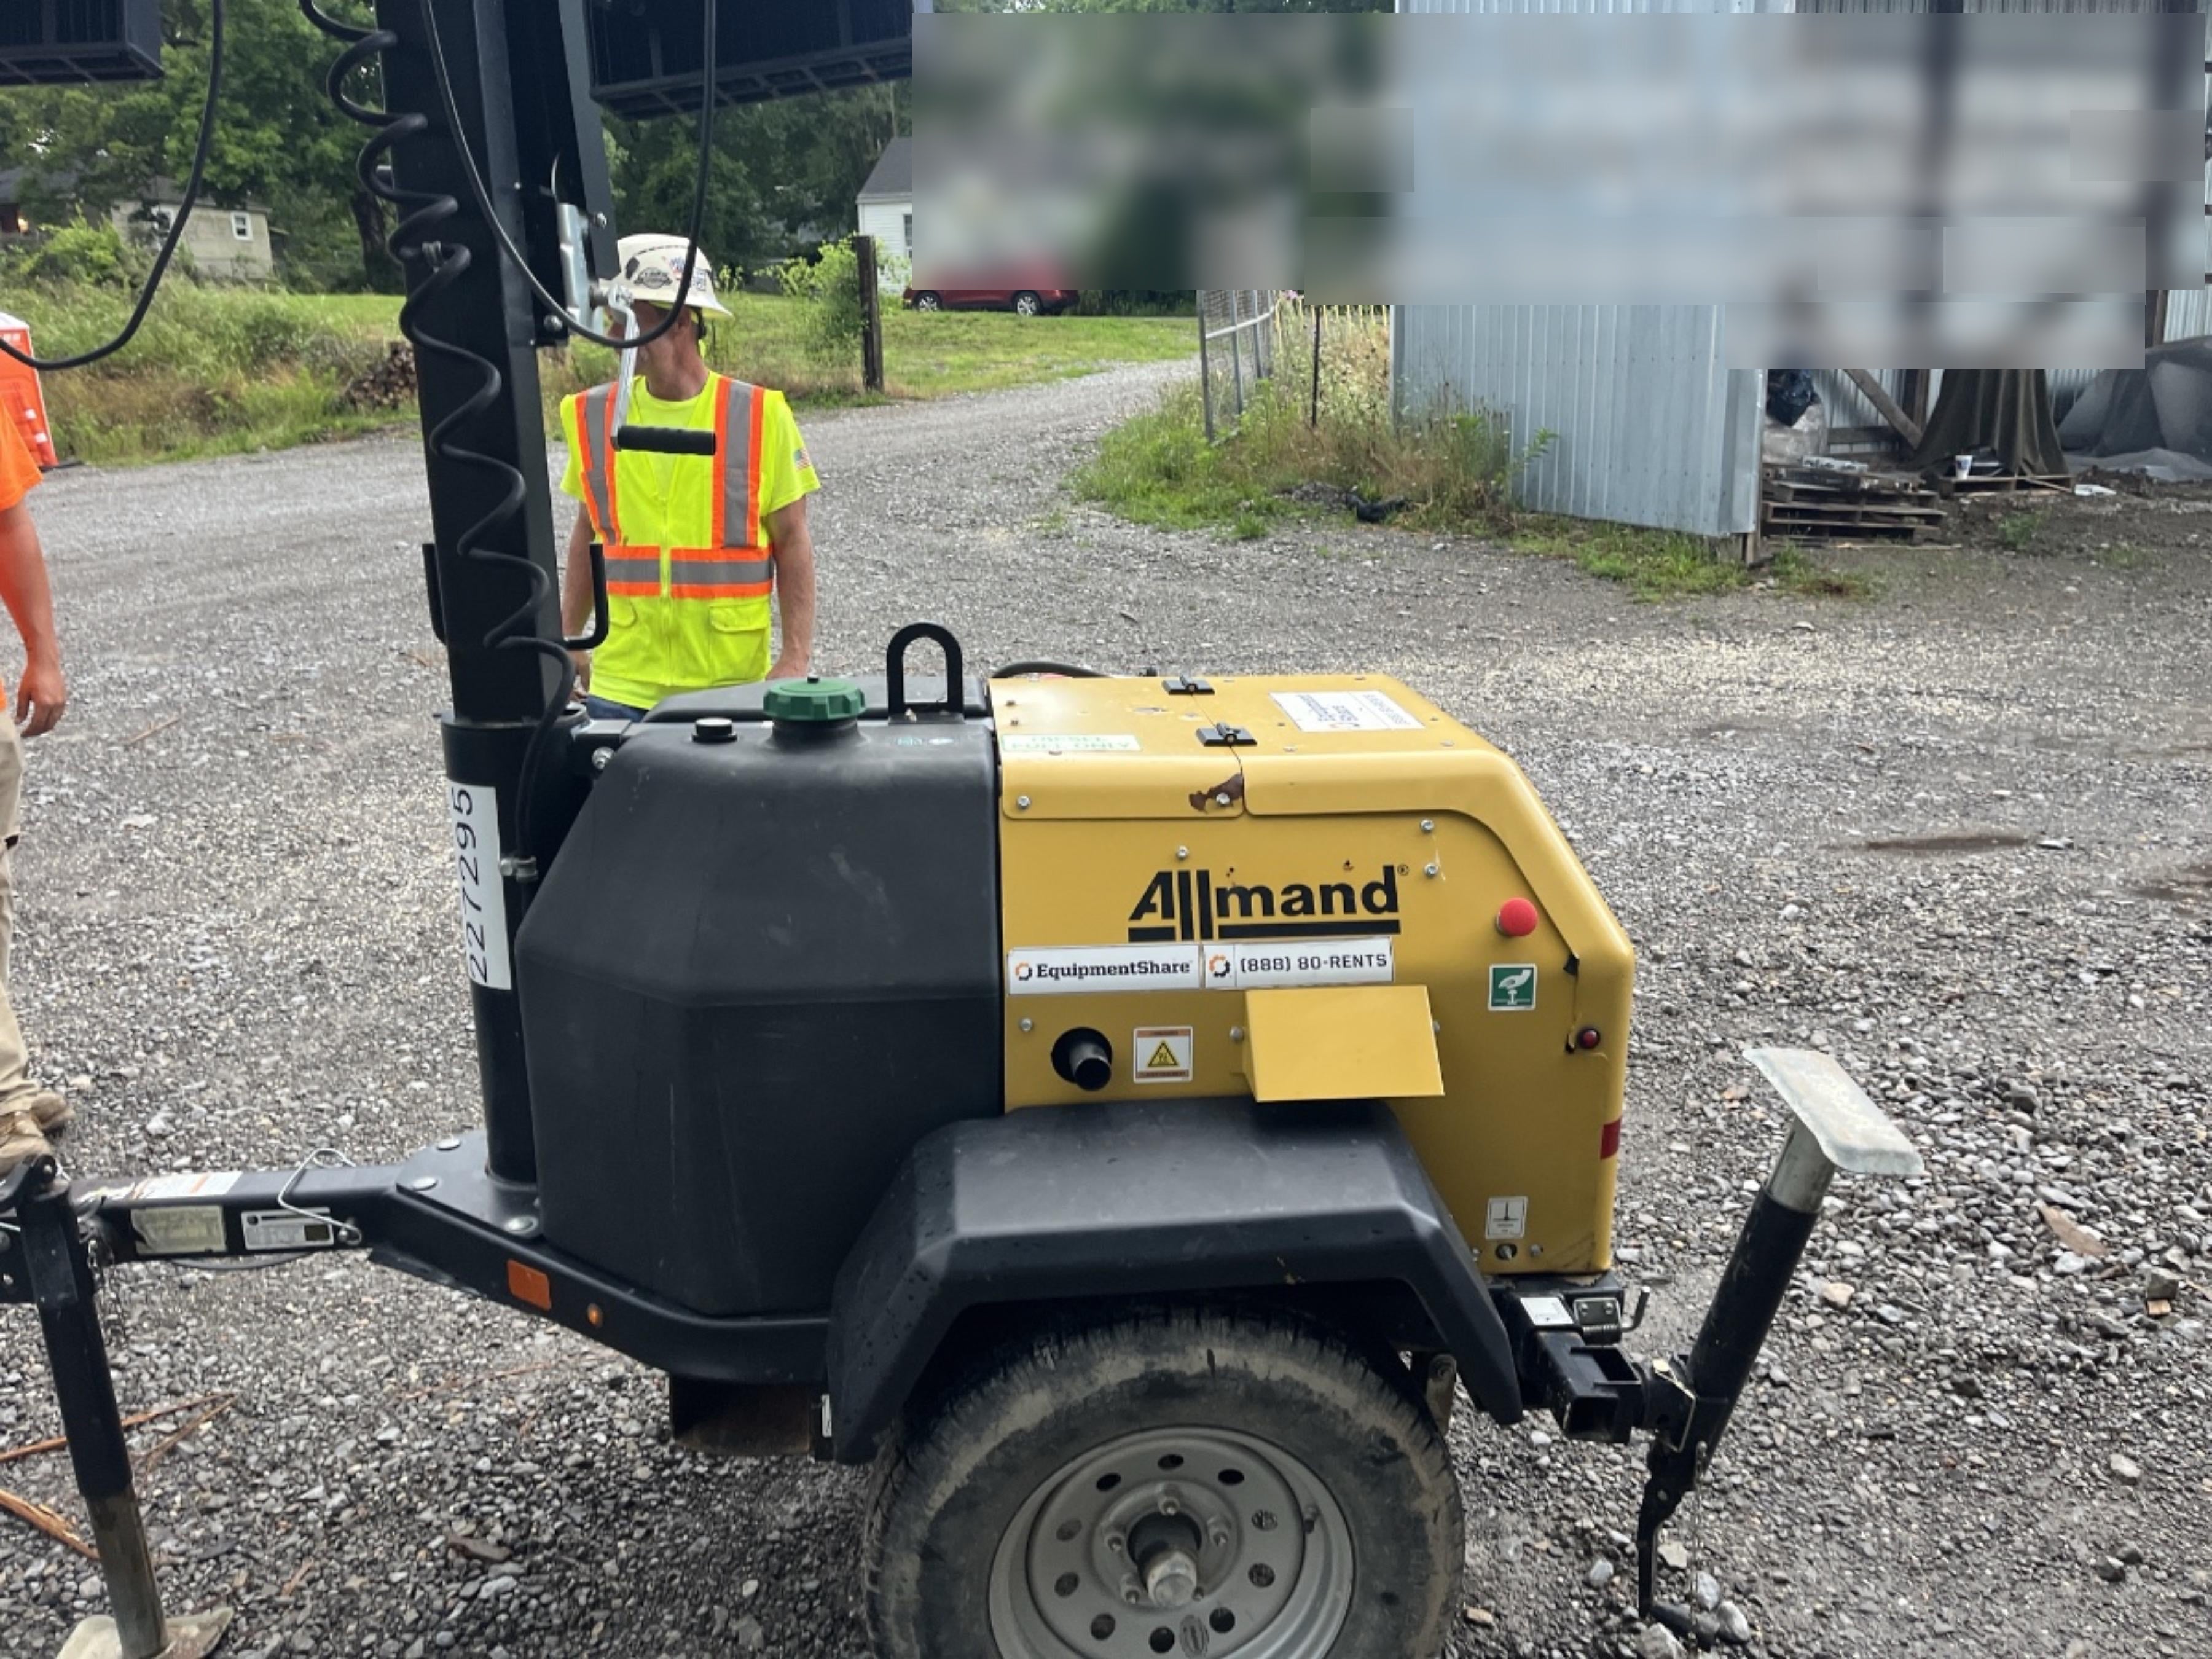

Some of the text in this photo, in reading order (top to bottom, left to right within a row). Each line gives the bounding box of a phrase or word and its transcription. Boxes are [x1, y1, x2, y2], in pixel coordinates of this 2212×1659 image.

[450, 786, 488, 984] 227295
[1037, 960, 1190, 980] EquipmentShare
[1240, 954, 1387, 973] (888) 80-RENTS
